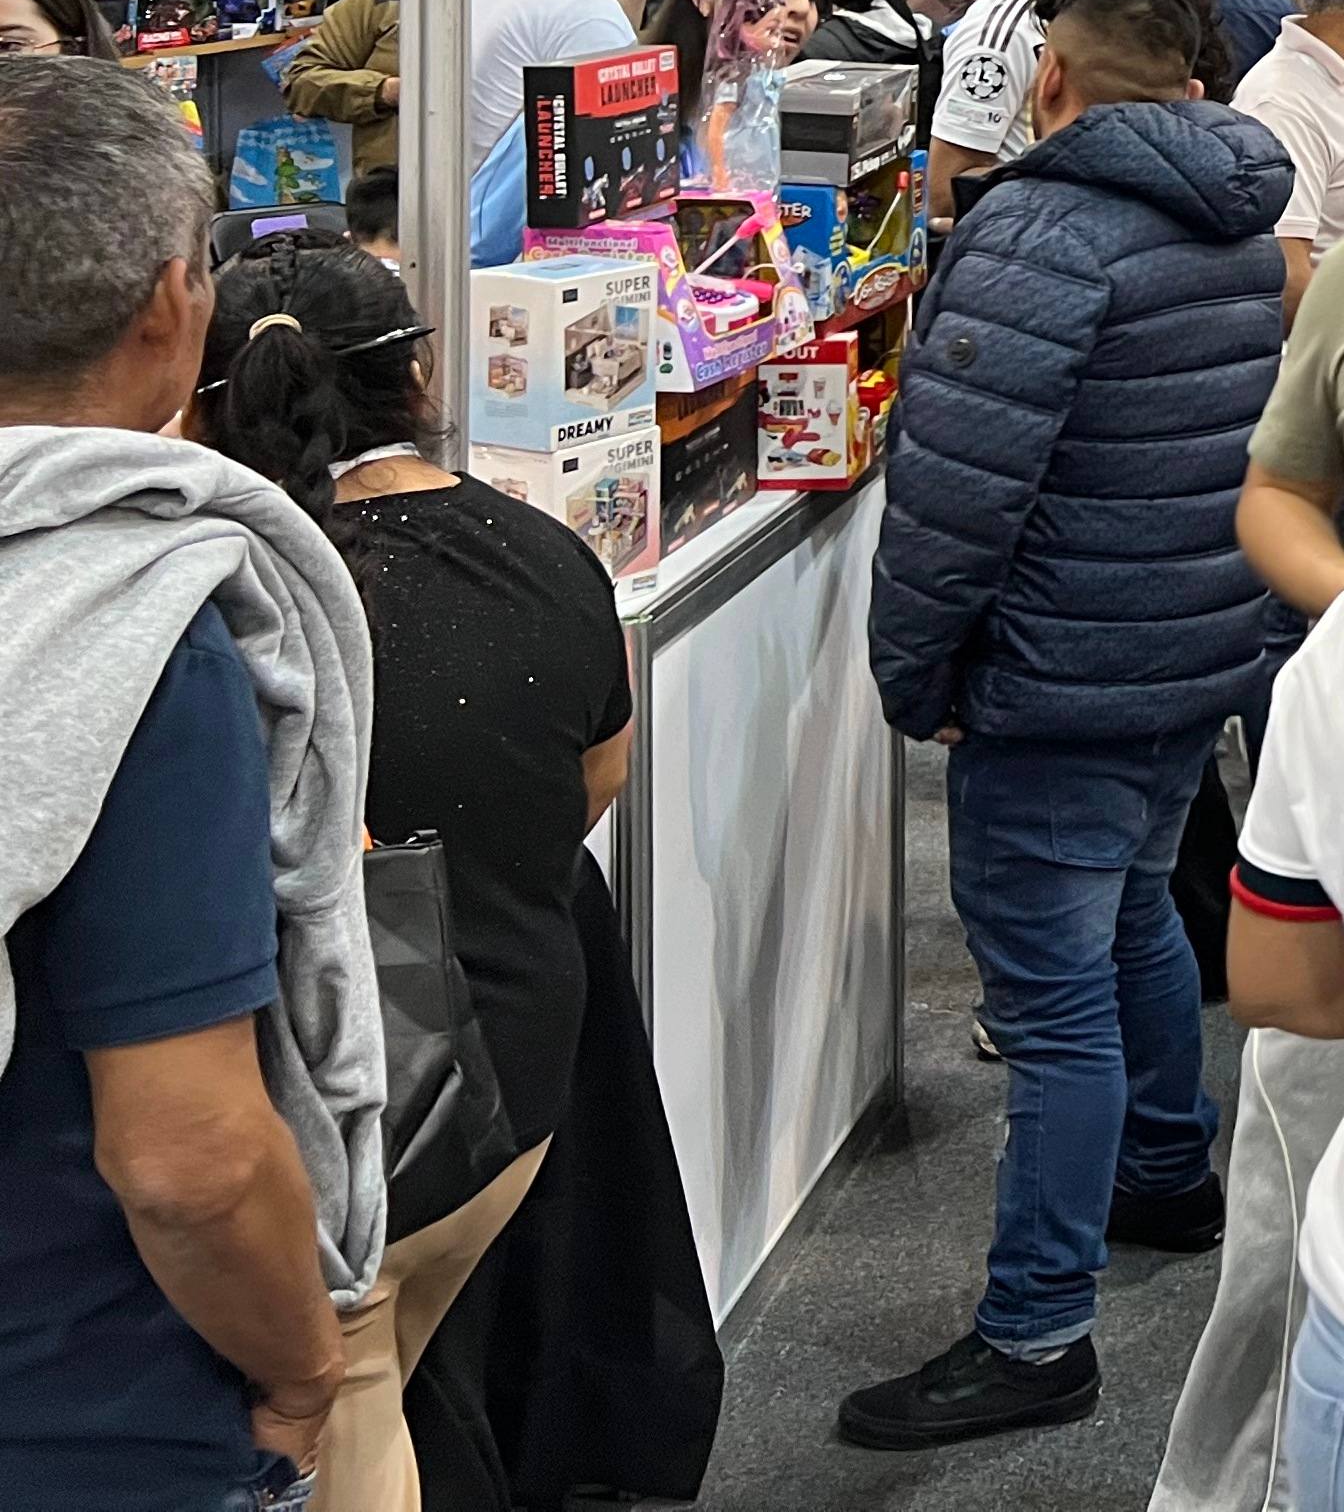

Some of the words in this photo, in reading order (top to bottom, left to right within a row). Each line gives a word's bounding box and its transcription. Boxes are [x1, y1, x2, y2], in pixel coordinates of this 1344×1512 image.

[973, 67, 993, 87] 15
[601, 76, 658, 106] LAUNCHER
[537, 100, 554, 195] LAUNCHER
[779, 203, 812, 218] TER
[606, 275, 650, 296] SUPER
[558, 416, 614, 442] DREAMY
[607, 440, 653, 464] SUPER
